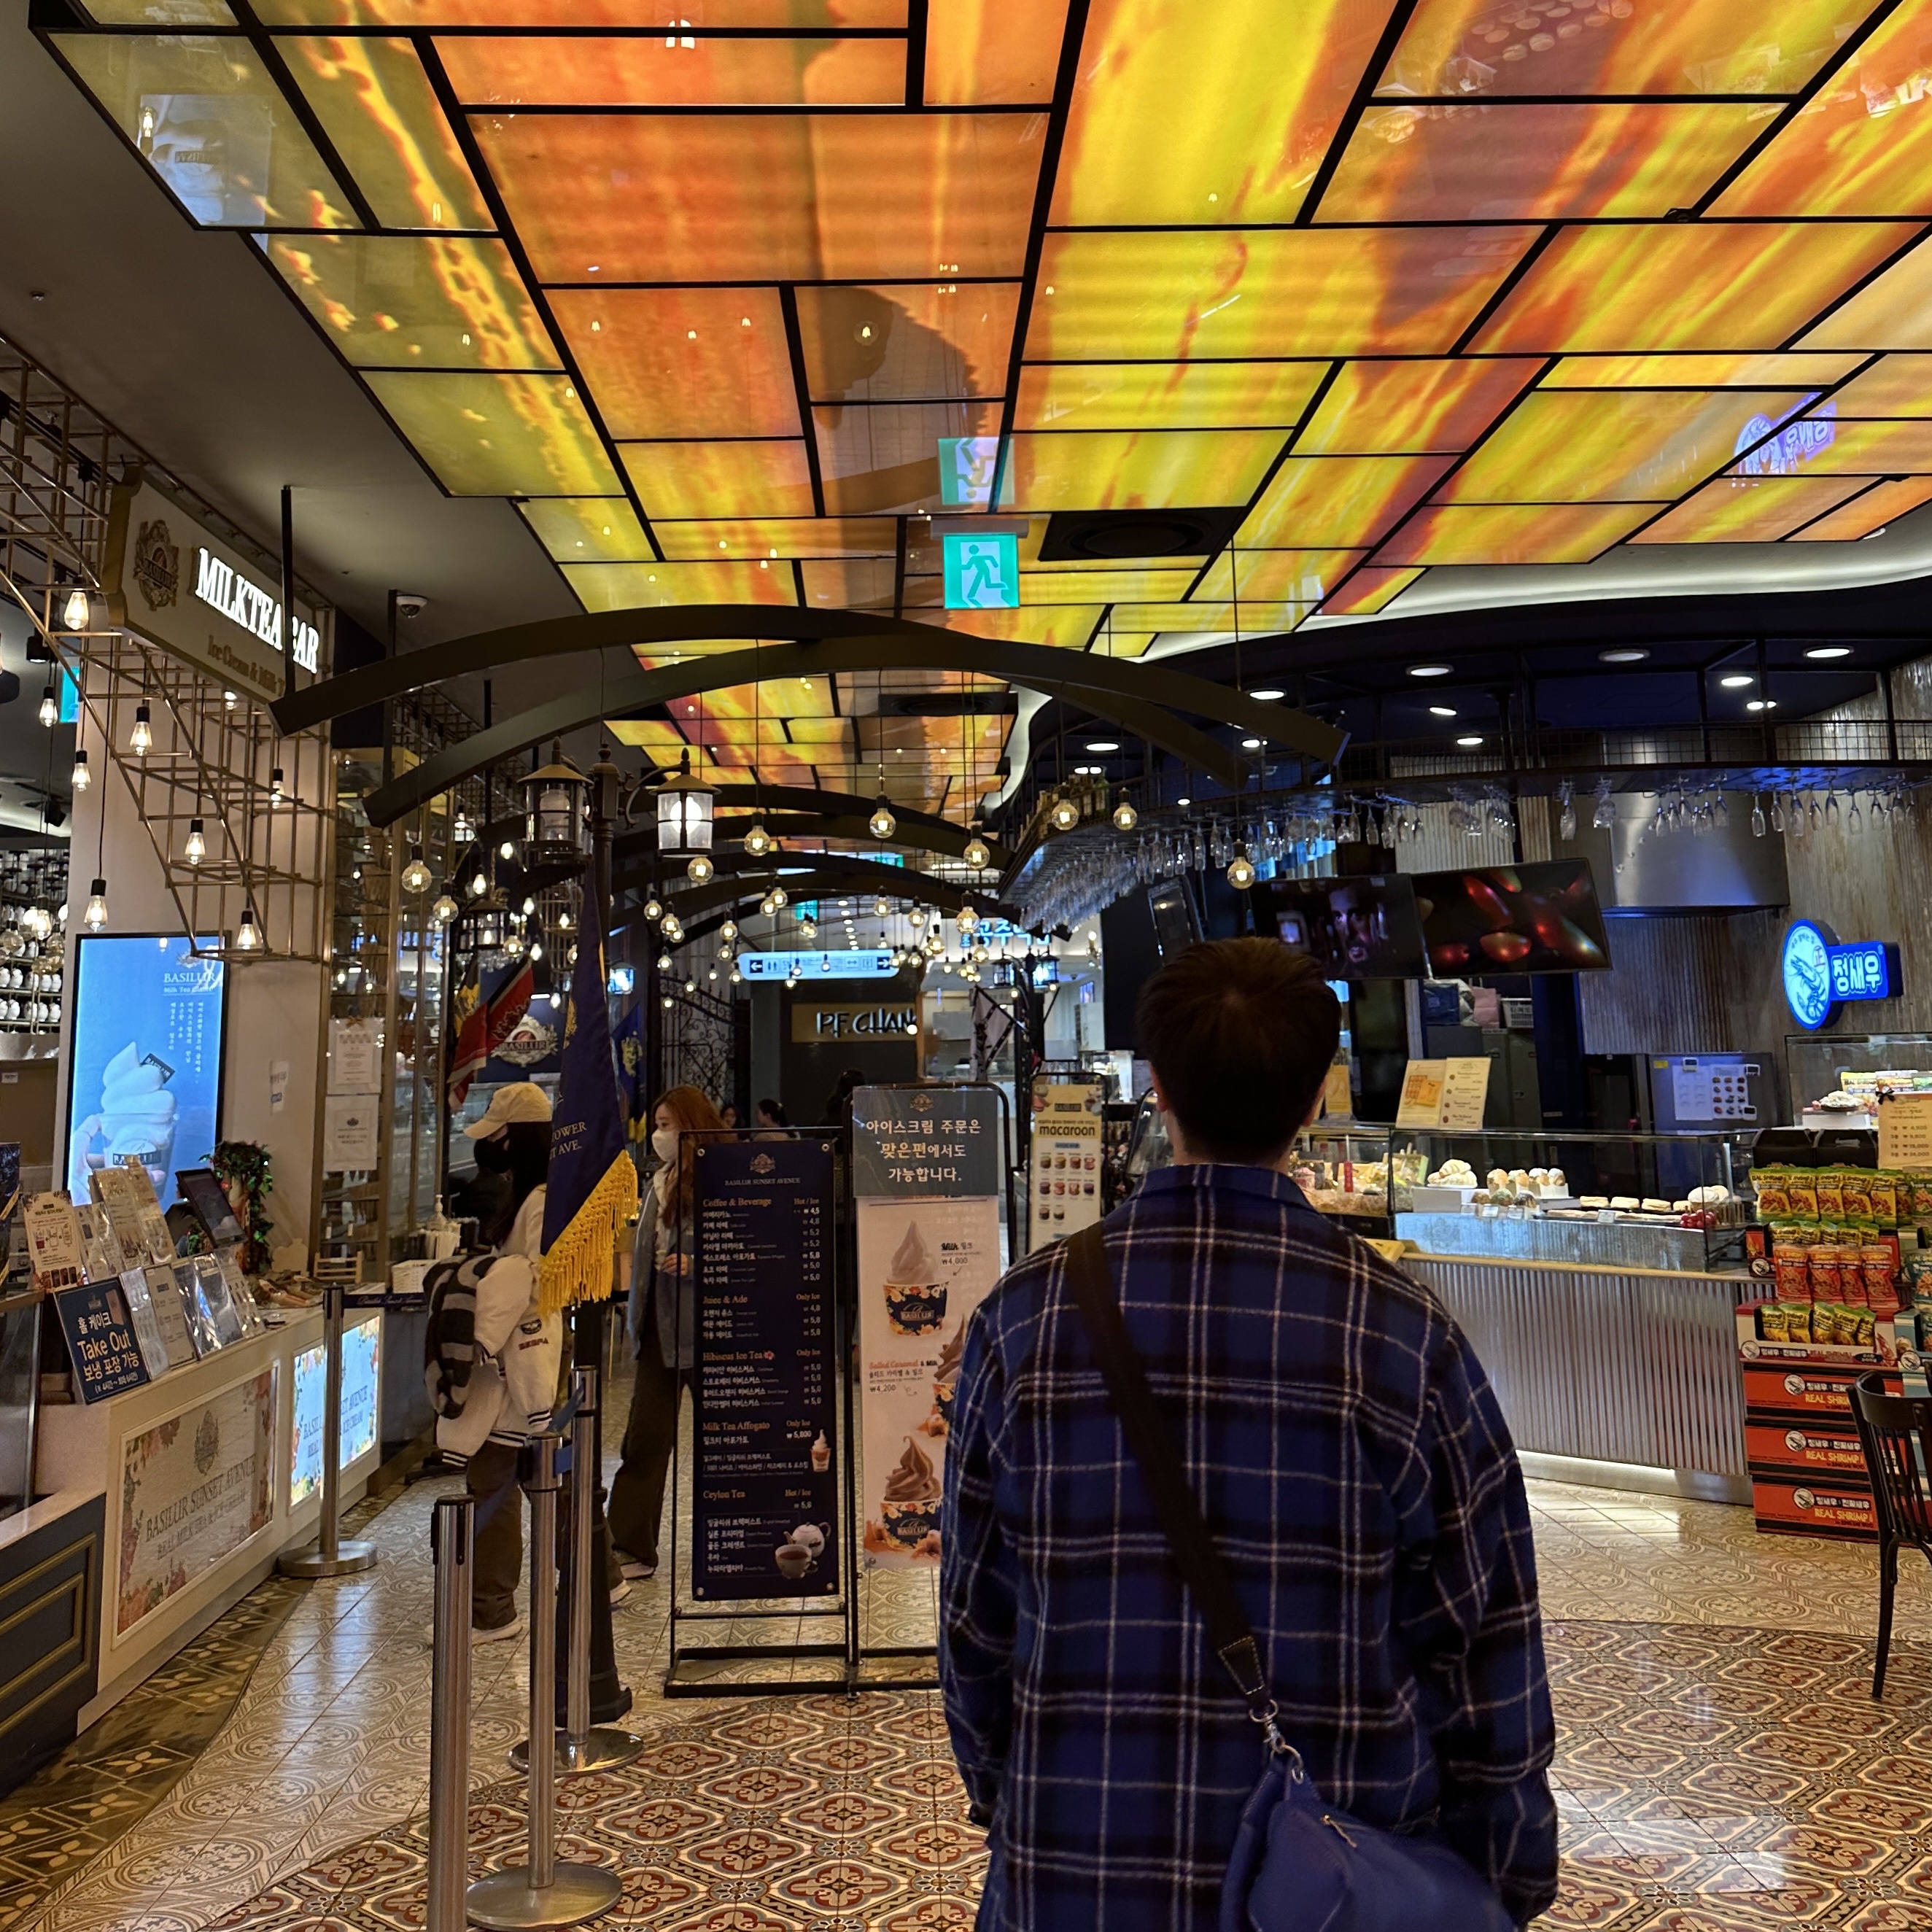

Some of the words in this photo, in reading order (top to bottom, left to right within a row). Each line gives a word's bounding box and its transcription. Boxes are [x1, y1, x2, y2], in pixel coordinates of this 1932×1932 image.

[195, 547, 283, 651] MILKTEA
[973, 918, 1052, 947] 공주
[1832, 953, 1882, 995] 정새우
[853, 1006, 917, 1034] CHAN
[502, 1040, 546, 1052] BASILUR
[866, 1120, 934, 1135] 아이스크림
[940, 1119, 982, 1134] 주문은
[1039, 1125, 1095, 1136] macaroon
[881, 1141, 967, 1160] 맞은편에서도
[888, 1167, 962, 1182] 가능합니다.
[702, 1199, 727, 1207] Coffee
[738, 1198, 772, 1207] Beverage
[77, 1317, 88, 1335] 홀
[88, 1311, 112, 1332] 케이크
[77, 1338, 108, 1362] Take
[109, 1330, 132, 1352] Out
[702, 1351, 734, 1361] Hibiscus
[748, 1351, 762, 1359] Tea
[82, 1361, 103, 1382] 보냉
[104, 1355, 123, 1376] 포장
[122, 1351, 140, 1369] 가능
[1805, 1393, 1826, 1403] REAL
[702, 1422, 721, 1431] Milk
[1805, 1450, 1827, 1461] REAL
[1828, 1451, 1860, 1464] SHRIMP
[146, 1496, 188, 1542] BASILUR
[190, 1473, 224, 1513] SUNSET
[224, 1453, 257, 1491] AVENUE
[732, 1489, 745, 1499] Tea
[1814, 1508, 1836, 1519] REAL
[1836, 1510, 1869, 1522] SHRIMP
